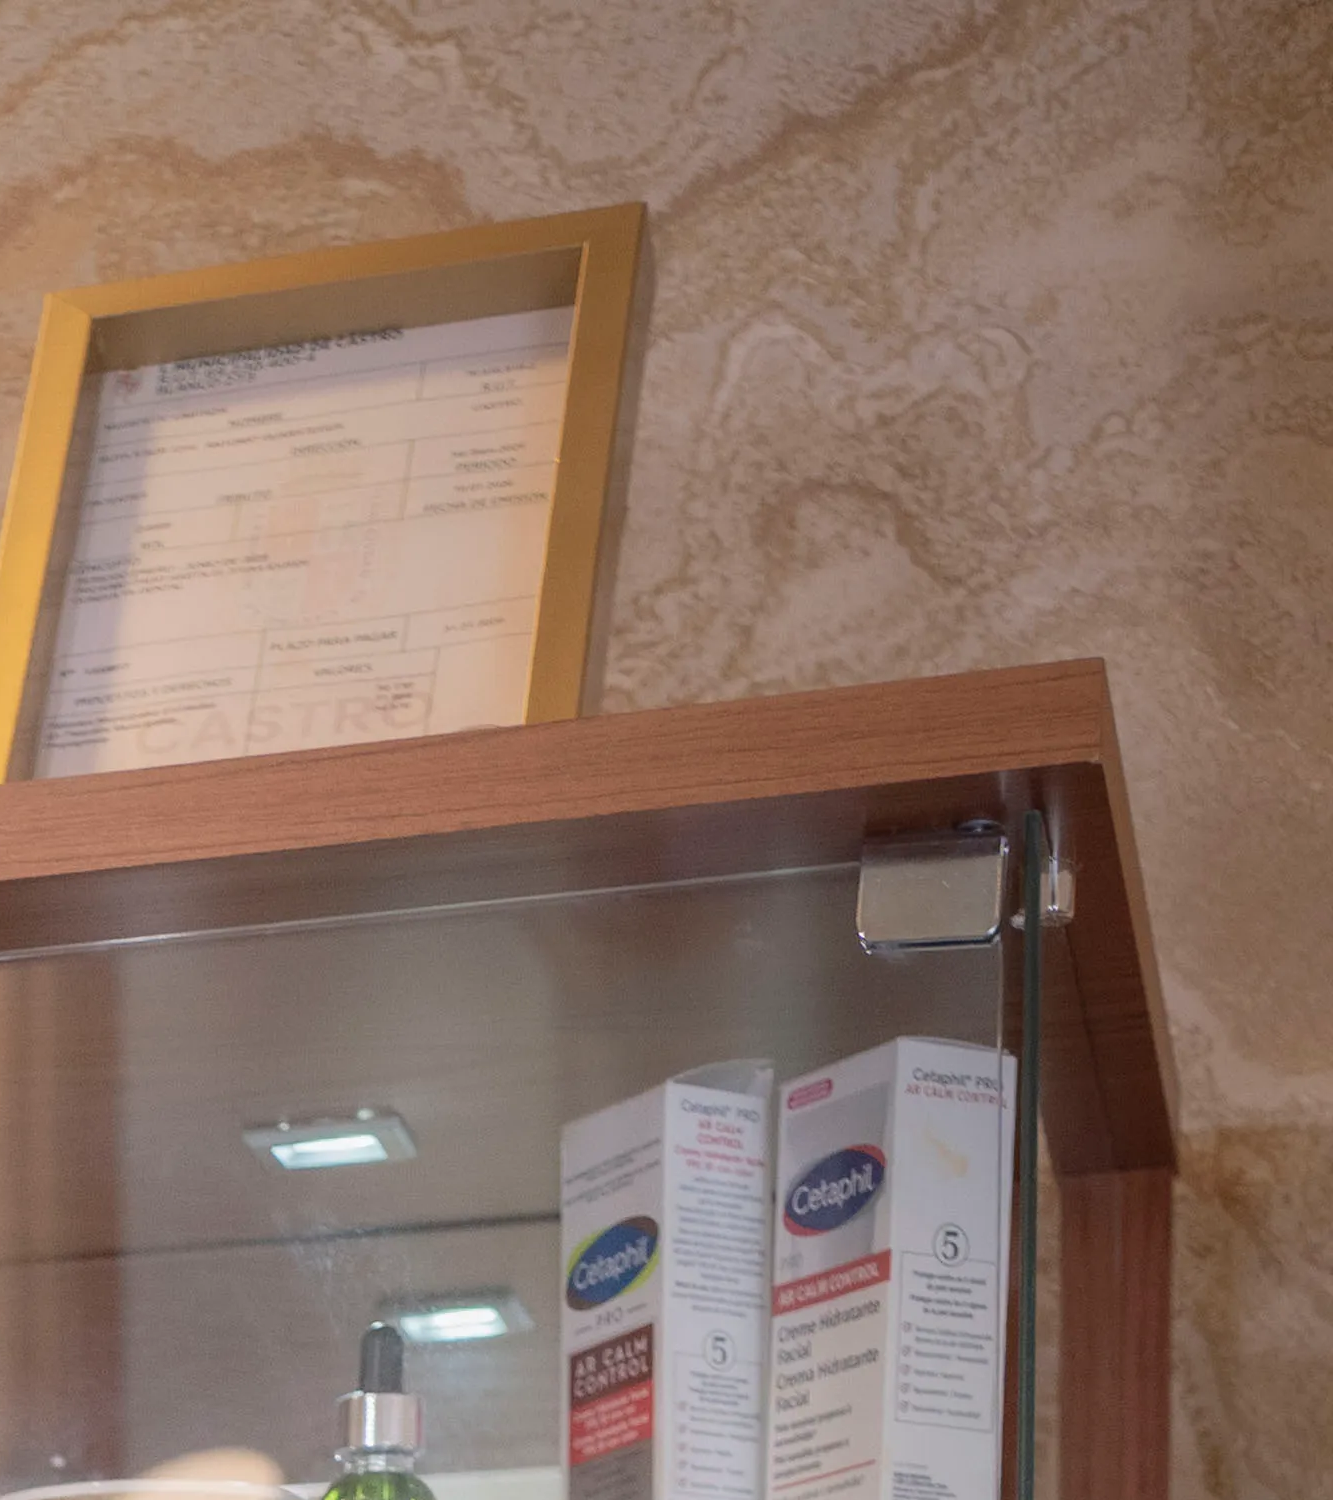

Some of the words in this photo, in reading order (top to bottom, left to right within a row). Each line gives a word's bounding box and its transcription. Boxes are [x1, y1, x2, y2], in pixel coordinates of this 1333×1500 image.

[791, 1162, 875, 1217] Cetaphil
[571, 1234, 650, 1292] Cetaphil
[941, 1230, 959, 1261] 5
[574, 1355, 597, 1379] AR
[600, 1334, 648, 1367] CALM
[711, 1335, 728, 1365] 5
[573, 1354, 649, 1400] CONTROL
